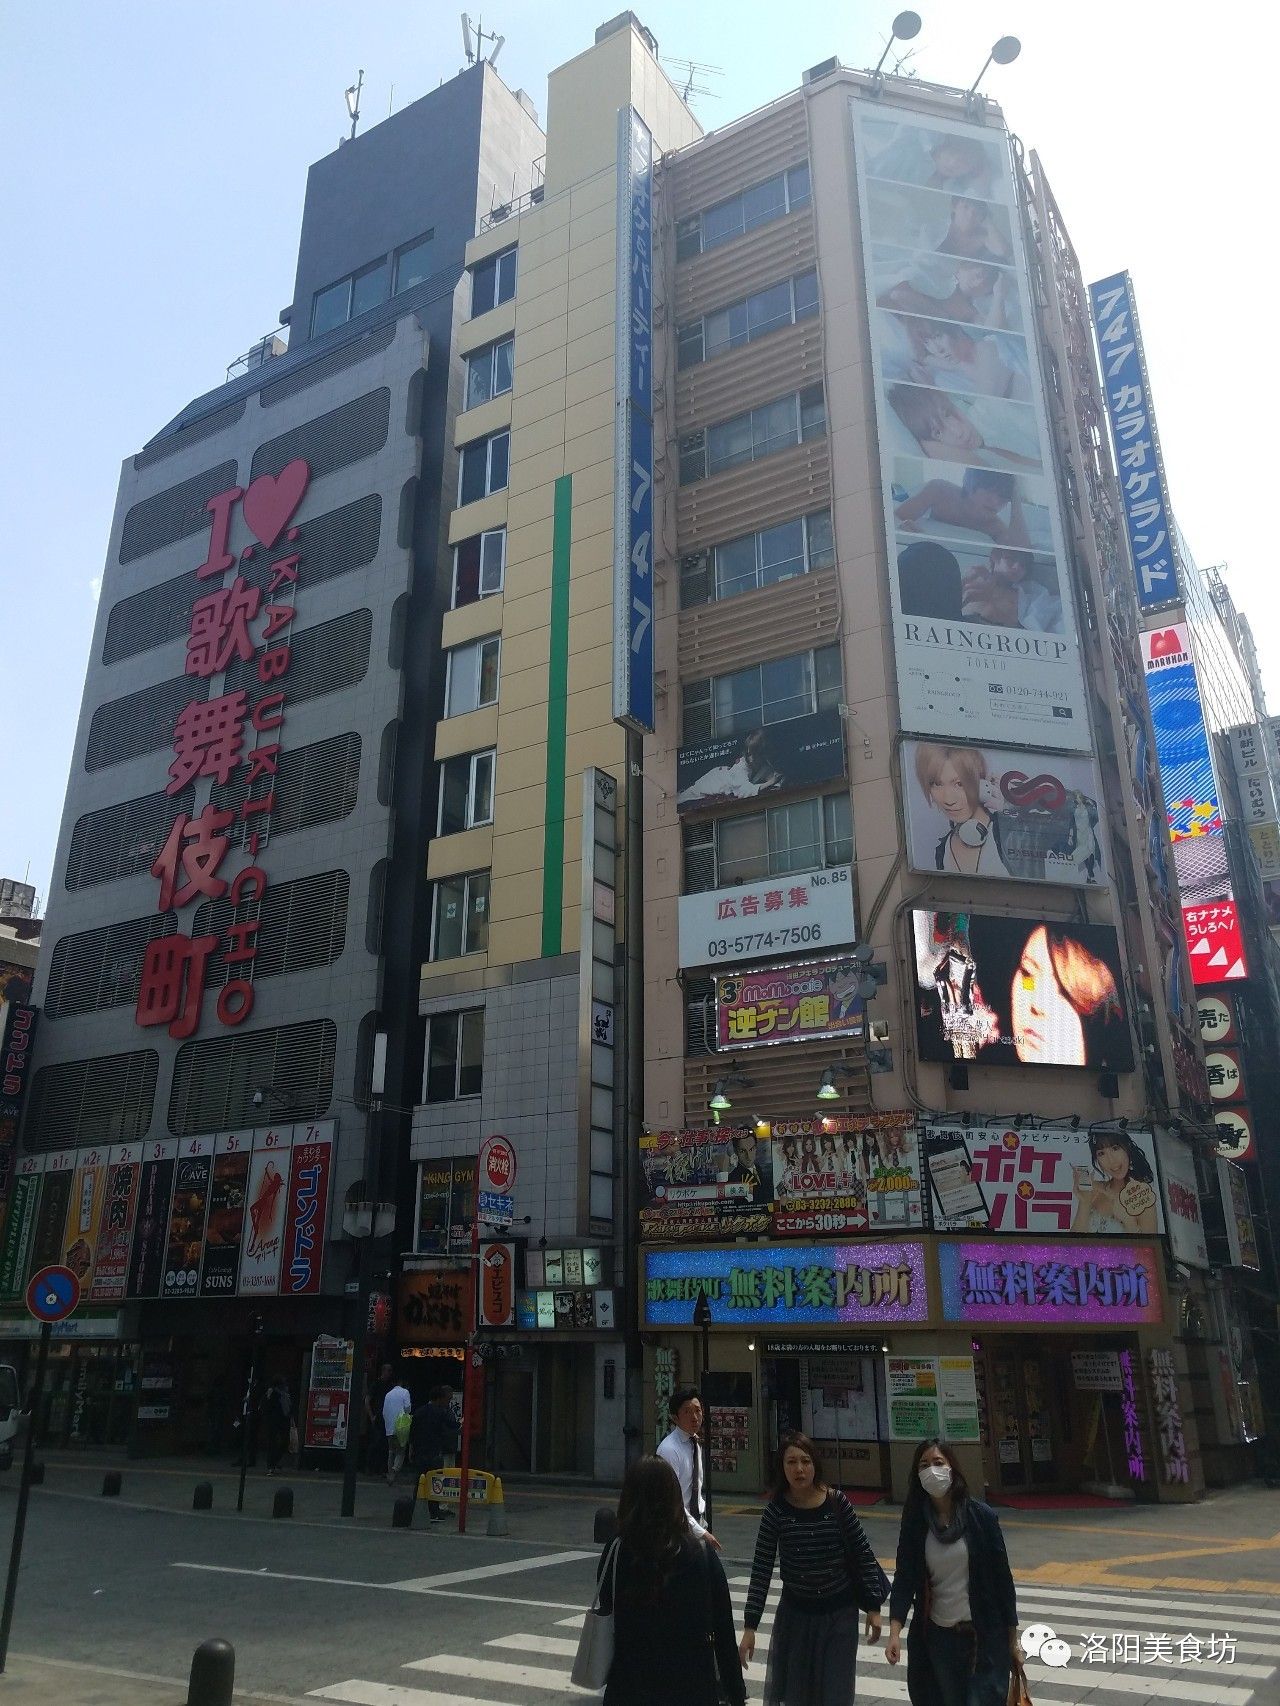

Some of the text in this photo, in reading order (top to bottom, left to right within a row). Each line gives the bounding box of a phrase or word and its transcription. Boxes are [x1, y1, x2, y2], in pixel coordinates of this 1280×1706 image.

[1098, 286, 1169, 594] 747 カラオケランド
[631, 460, 651, 657] 747
[904, 622, 1068, 662] RAINGROUP
[1147, 652, 1189, 670] MARUHAN
[136, 575, 261, 1040] 歌舞伎町
[811, 870, 848, 890] No.85
[717, 886, 810, 921] 広告募集
[1186, 906, 1232, 922] 右ナナメ
[708, 922, 822, 958] 03-5774-7506
[728, 995, 830, 1040] 逆ナン館
[227, 1135, 240, 1151] 5F
[266, 1131, 280, 1147] 6F
[307, 1126, 320, 1142] 7F
[121, 1147, 132, 1163] 2F
[154, 1143, 166, 1158] 3F
[189, 1140, 202, 1155] 4F
[970, 1131, 1062, 1184] ポケ
[488, 1155, 510, 1176] 消火栓
[455, 1170, 474, 1183] GYM
[792, 1172, 837, 1190] LOVE
[988, 1180, 1072, 1229] パラ
[289, 1163, 323, 1293] ゴンドラ
[776, 1213, 848, 1231] ここから30秒
[205, 1274, 233, 1289] SUNS
[646, 1264, 913, 1309] 歌舞伎町 無料案内所
[961, 1259, 1150, 1308] 無料案内所
